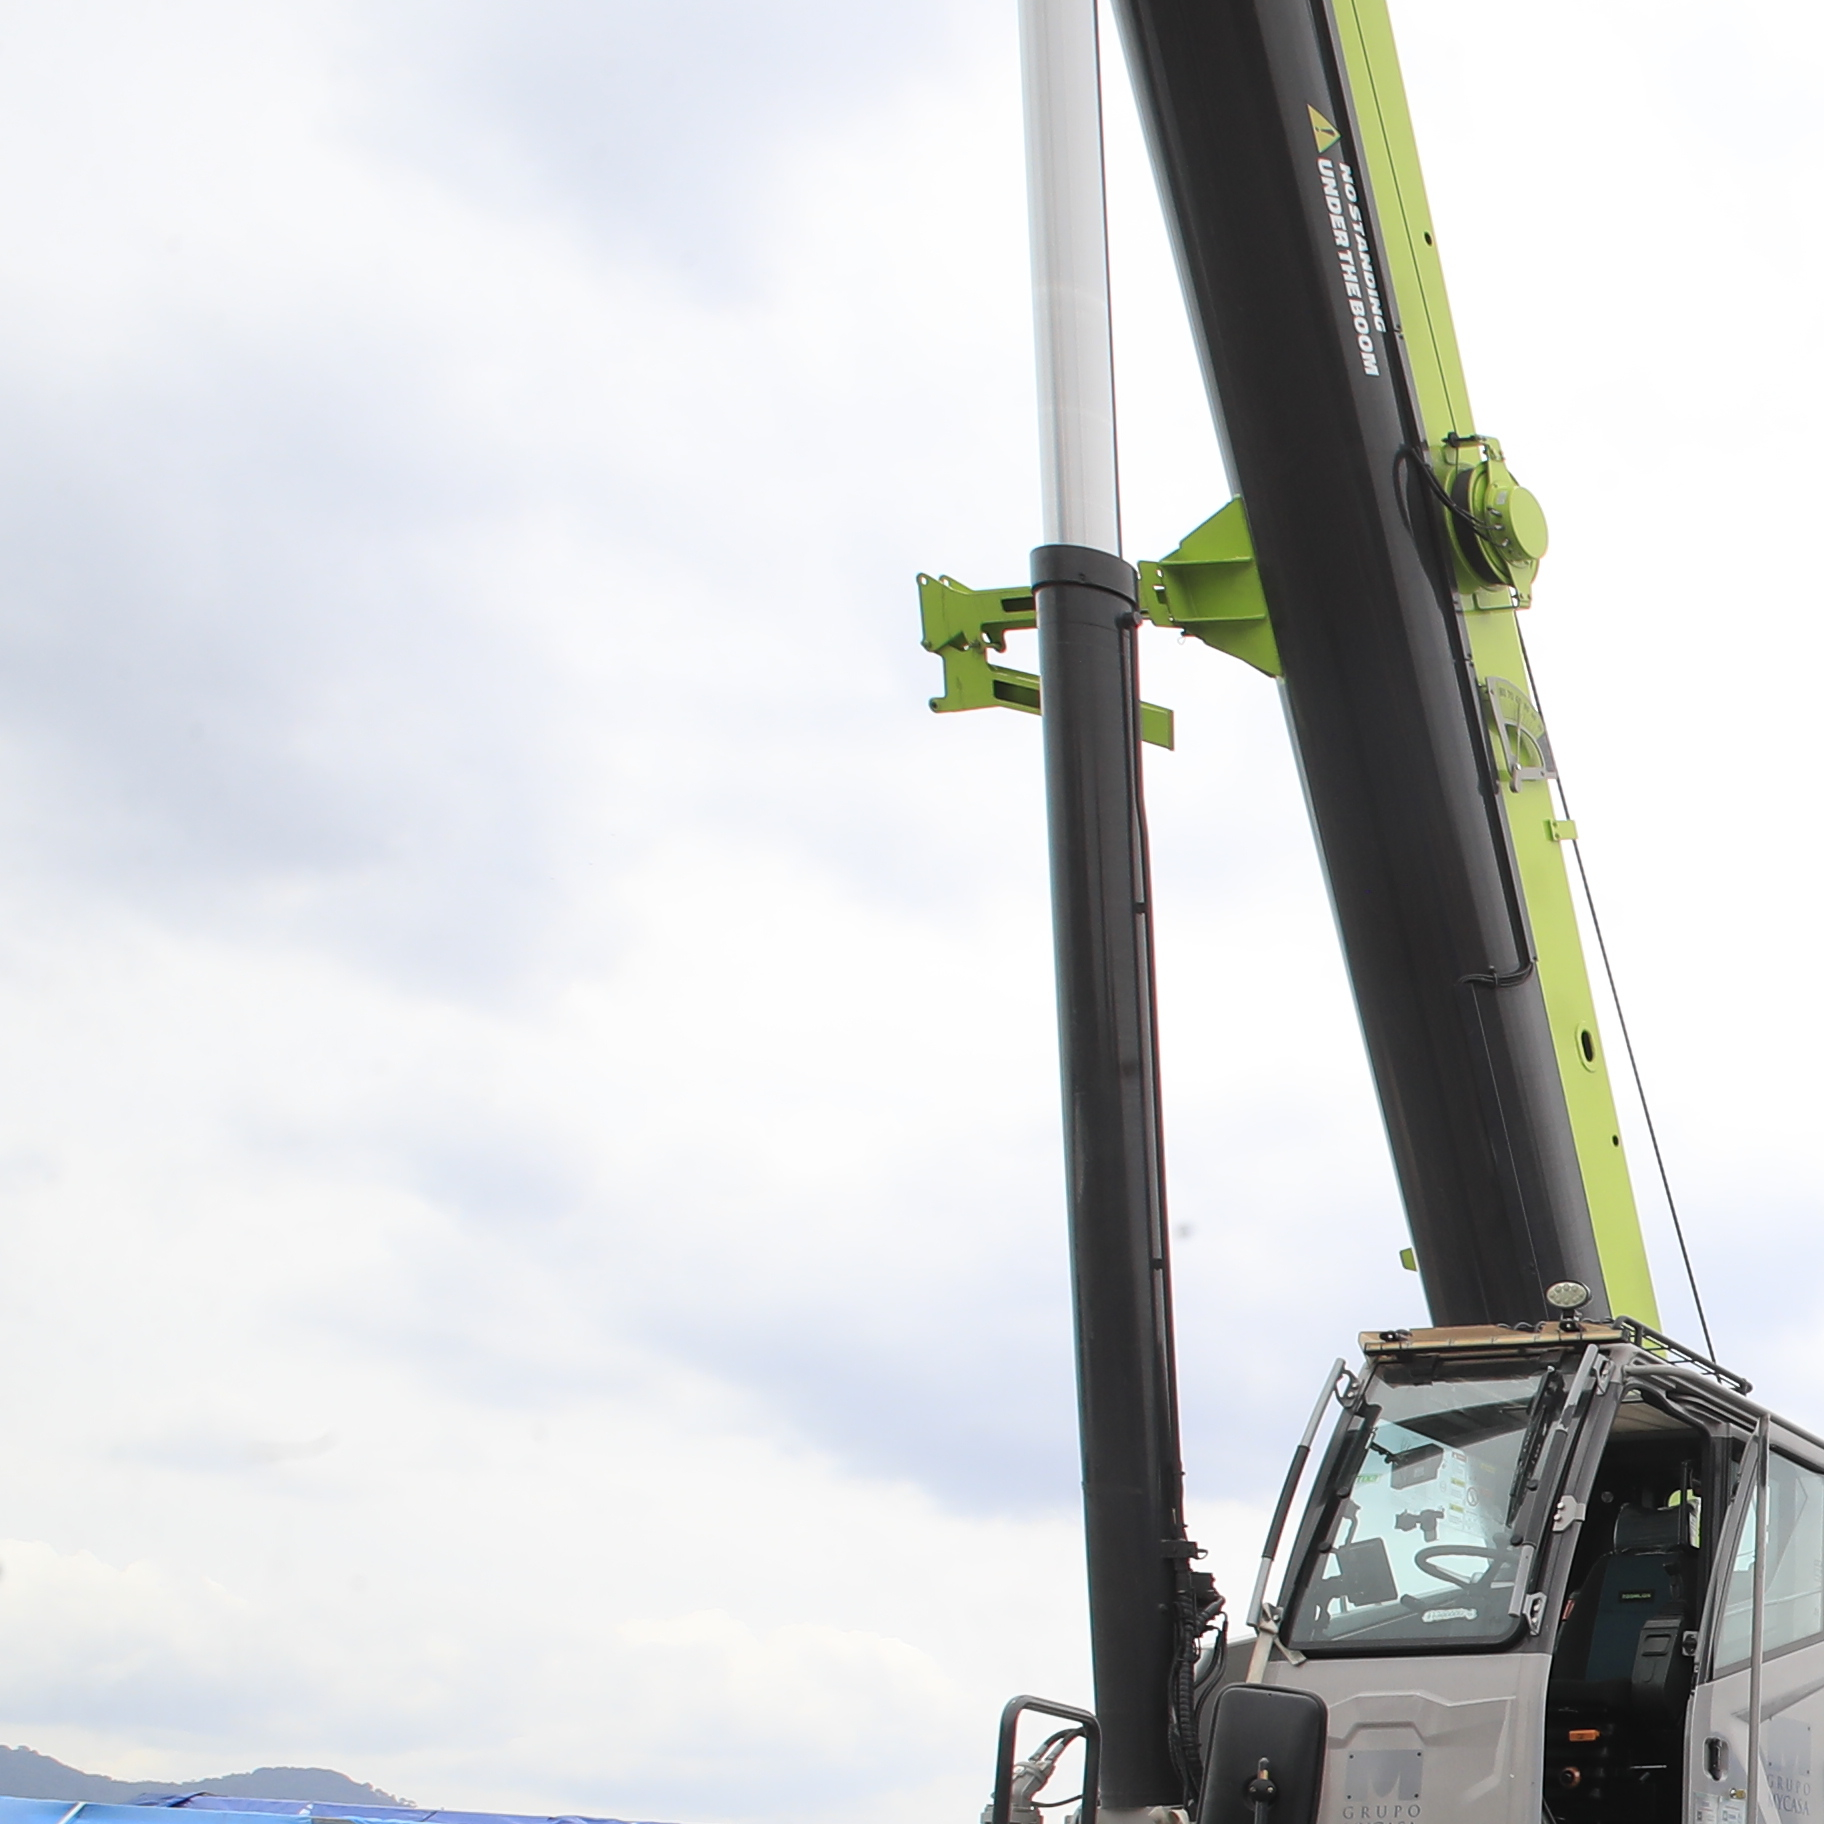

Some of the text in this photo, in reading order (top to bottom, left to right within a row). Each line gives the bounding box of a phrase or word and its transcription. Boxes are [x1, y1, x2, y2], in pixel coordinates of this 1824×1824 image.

[1317, 158, 1380, 377] UNDER THE BOOM
[1339, 163, 1387, 333] NO STANDING
[1342, 1804, 1421, 1820] GRUPO
[1767, 1774, 1811, 1796] GRUPO
